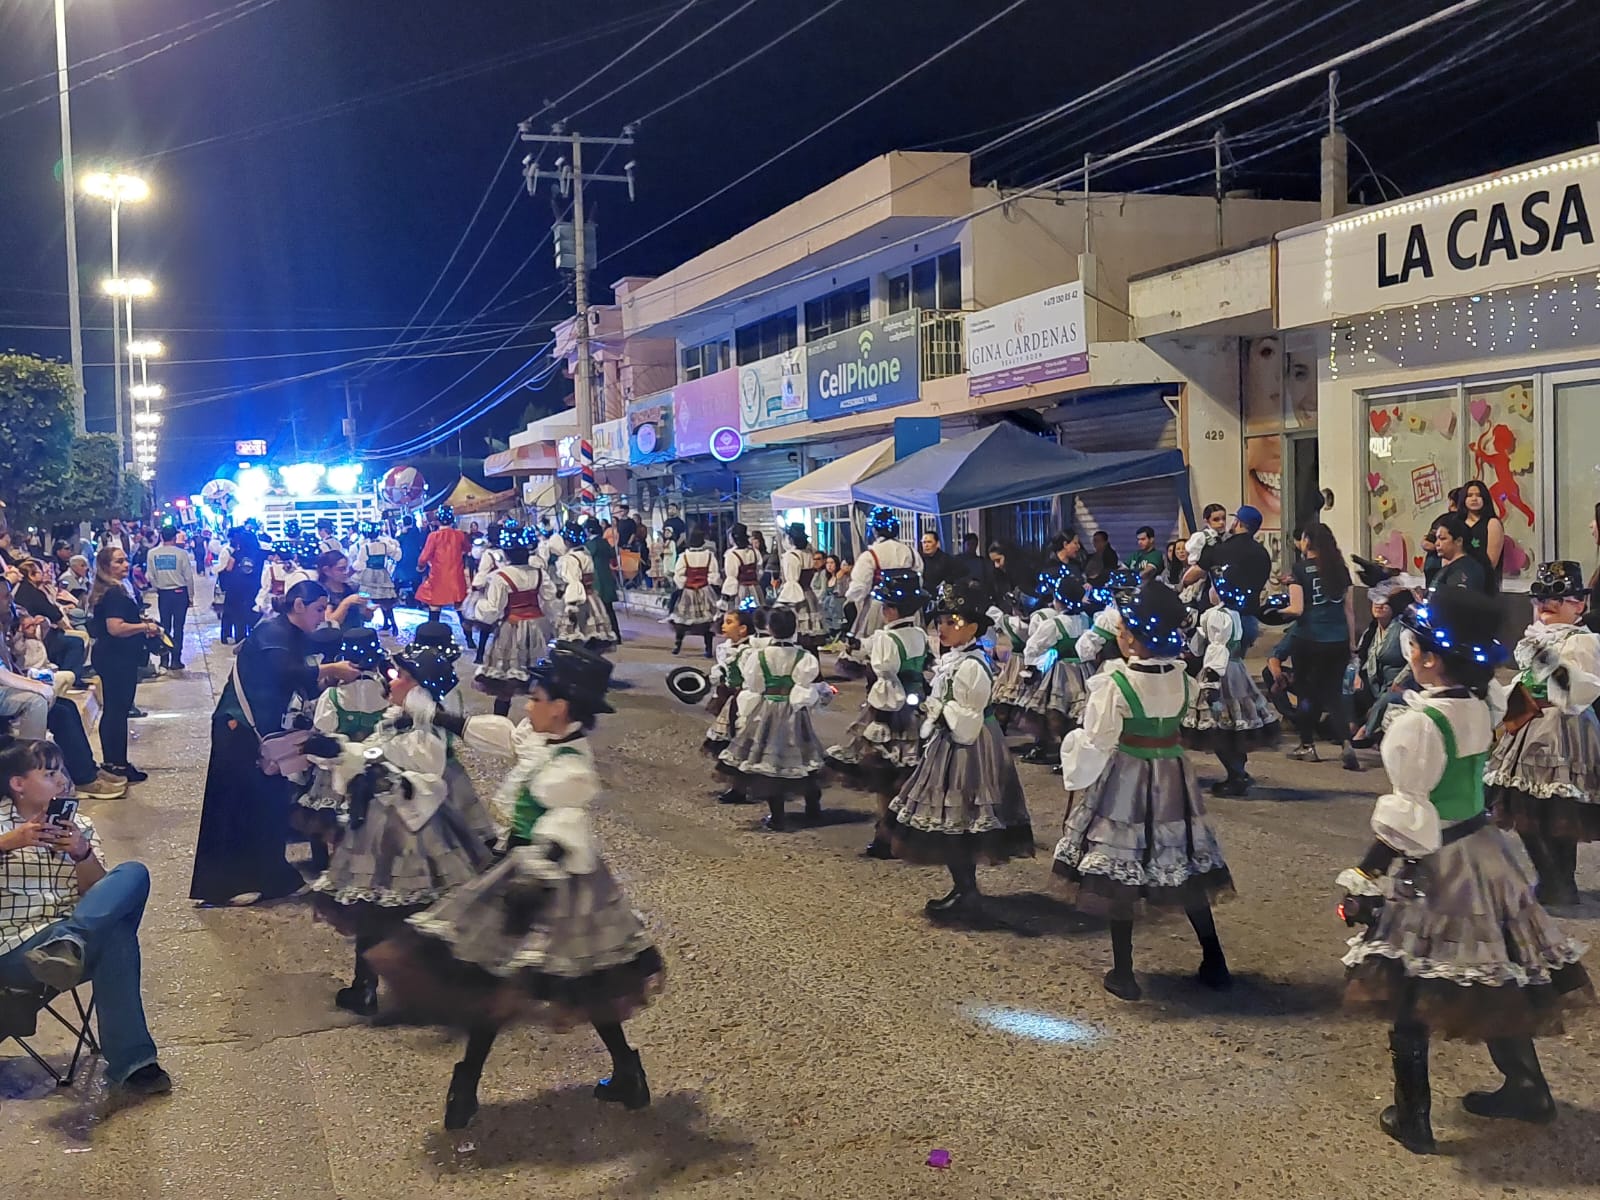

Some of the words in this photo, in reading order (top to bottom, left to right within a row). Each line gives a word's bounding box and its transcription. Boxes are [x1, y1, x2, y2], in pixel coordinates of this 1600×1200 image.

[1377, 223, 1434, 288] LA
[1447, 183, 1595, 271] CASA
[972, 343, 1002, 365] GINA
[1005, 322, 1077, 356] CARDENAS
[819, 357, 901, 399] CellPhone
[1204, 430, 1225, 441] 429
